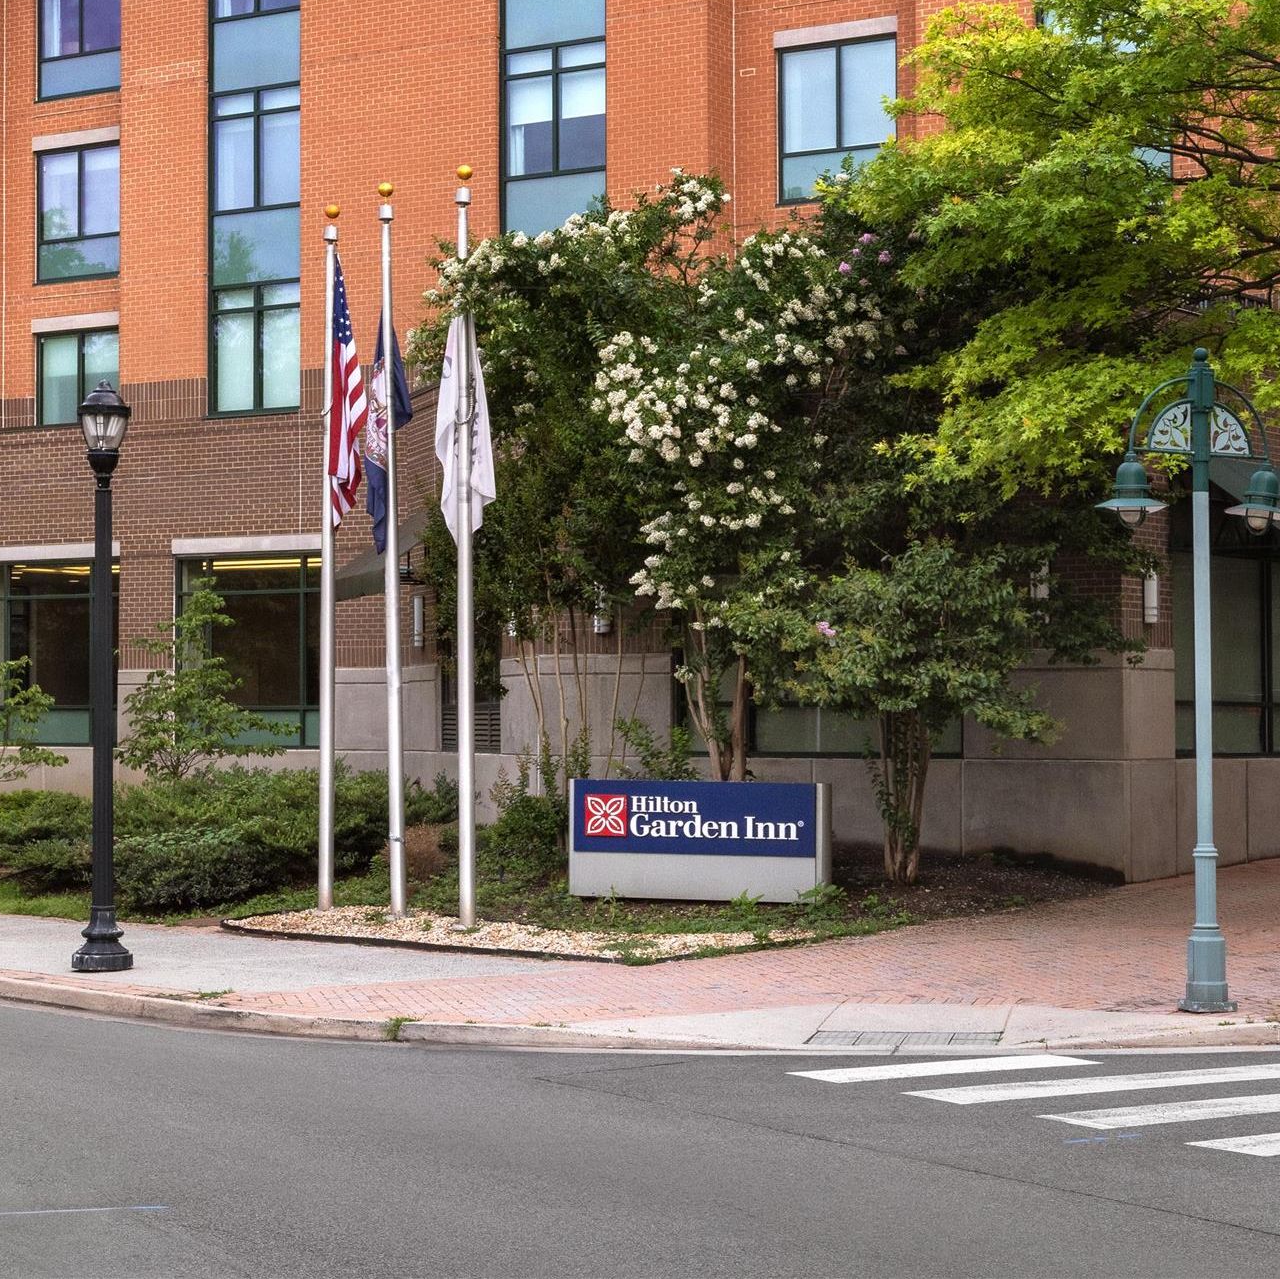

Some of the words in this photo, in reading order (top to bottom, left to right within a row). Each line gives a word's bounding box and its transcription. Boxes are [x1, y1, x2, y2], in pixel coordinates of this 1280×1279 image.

[631, 795, 698, 814] Hilton
[630, 813, 740, 839] Garden
[744, 816, 799, 841] Inn
